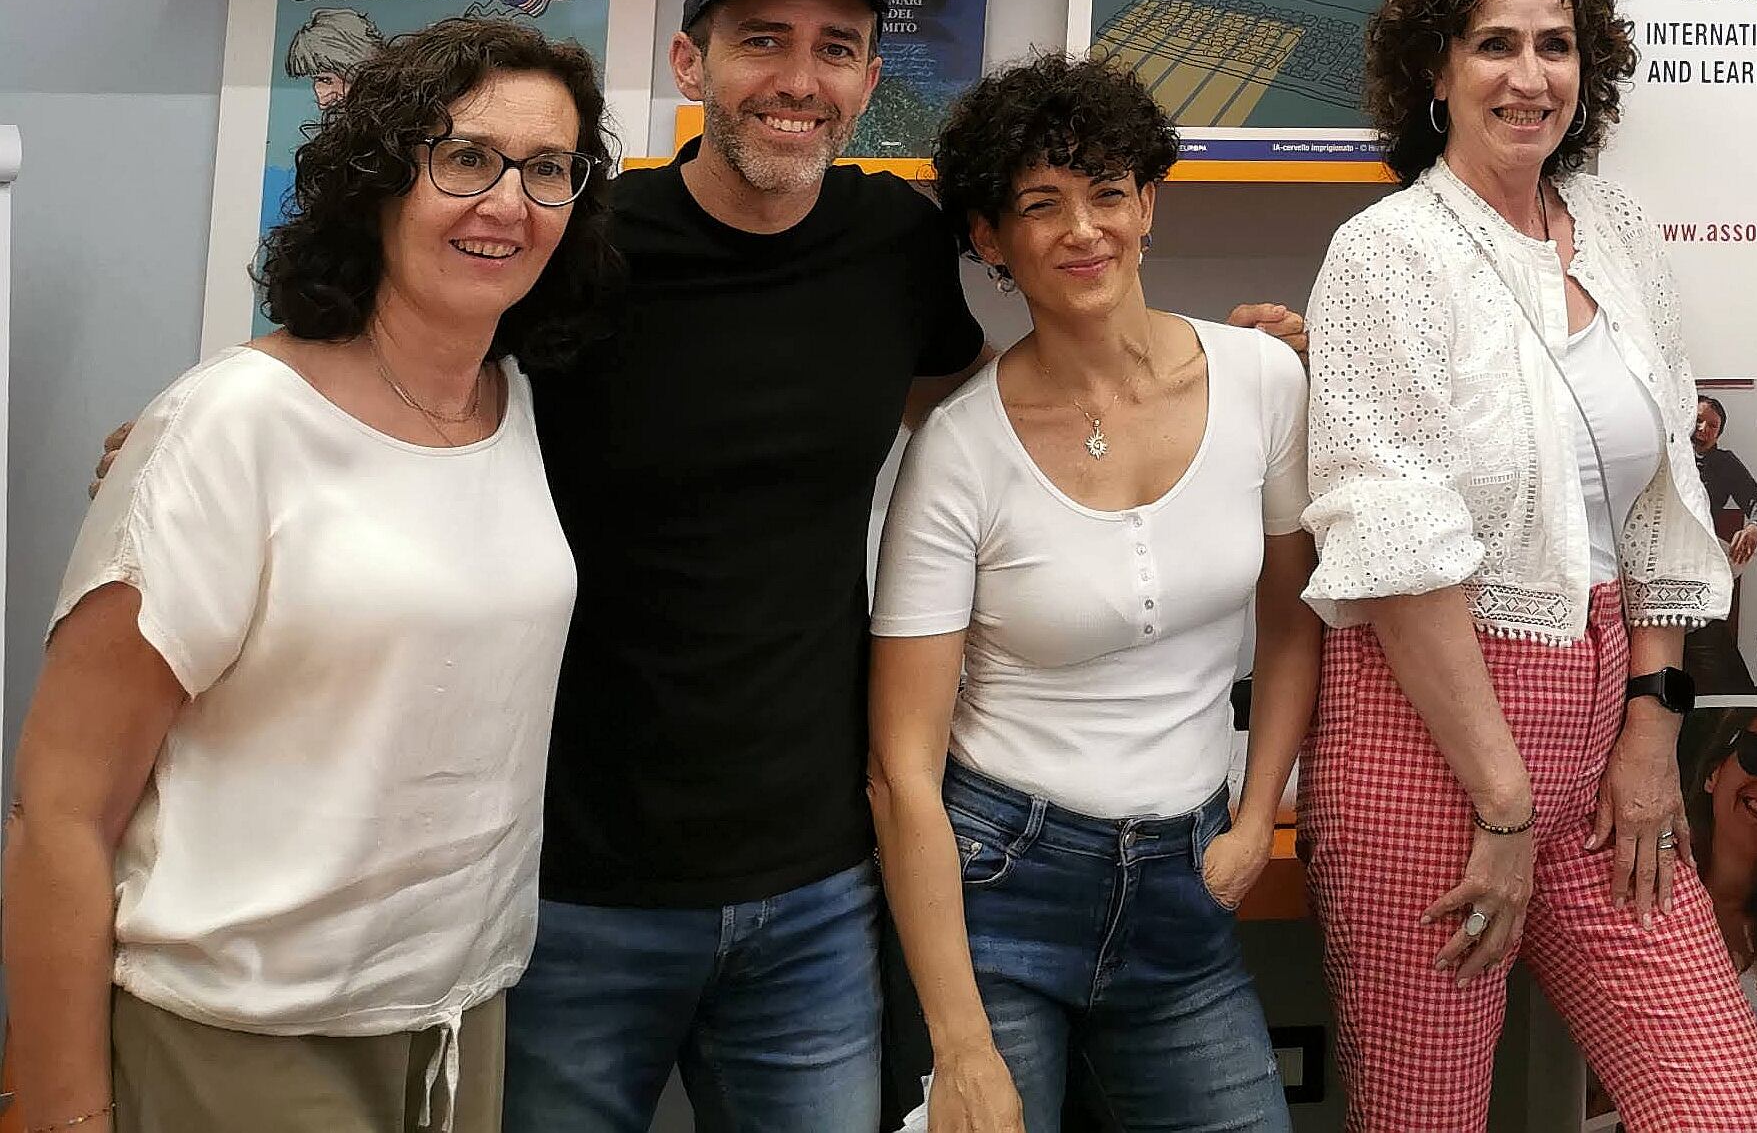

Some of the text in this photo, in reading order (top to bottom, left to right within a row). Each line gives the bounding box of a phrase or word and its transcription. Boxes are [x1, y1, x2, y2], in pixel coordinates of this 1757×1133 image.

[888, 8, 914, 19] DEL
[881, 22, 918, 33] MITO
[1647, 60, 1692, 84] AND
